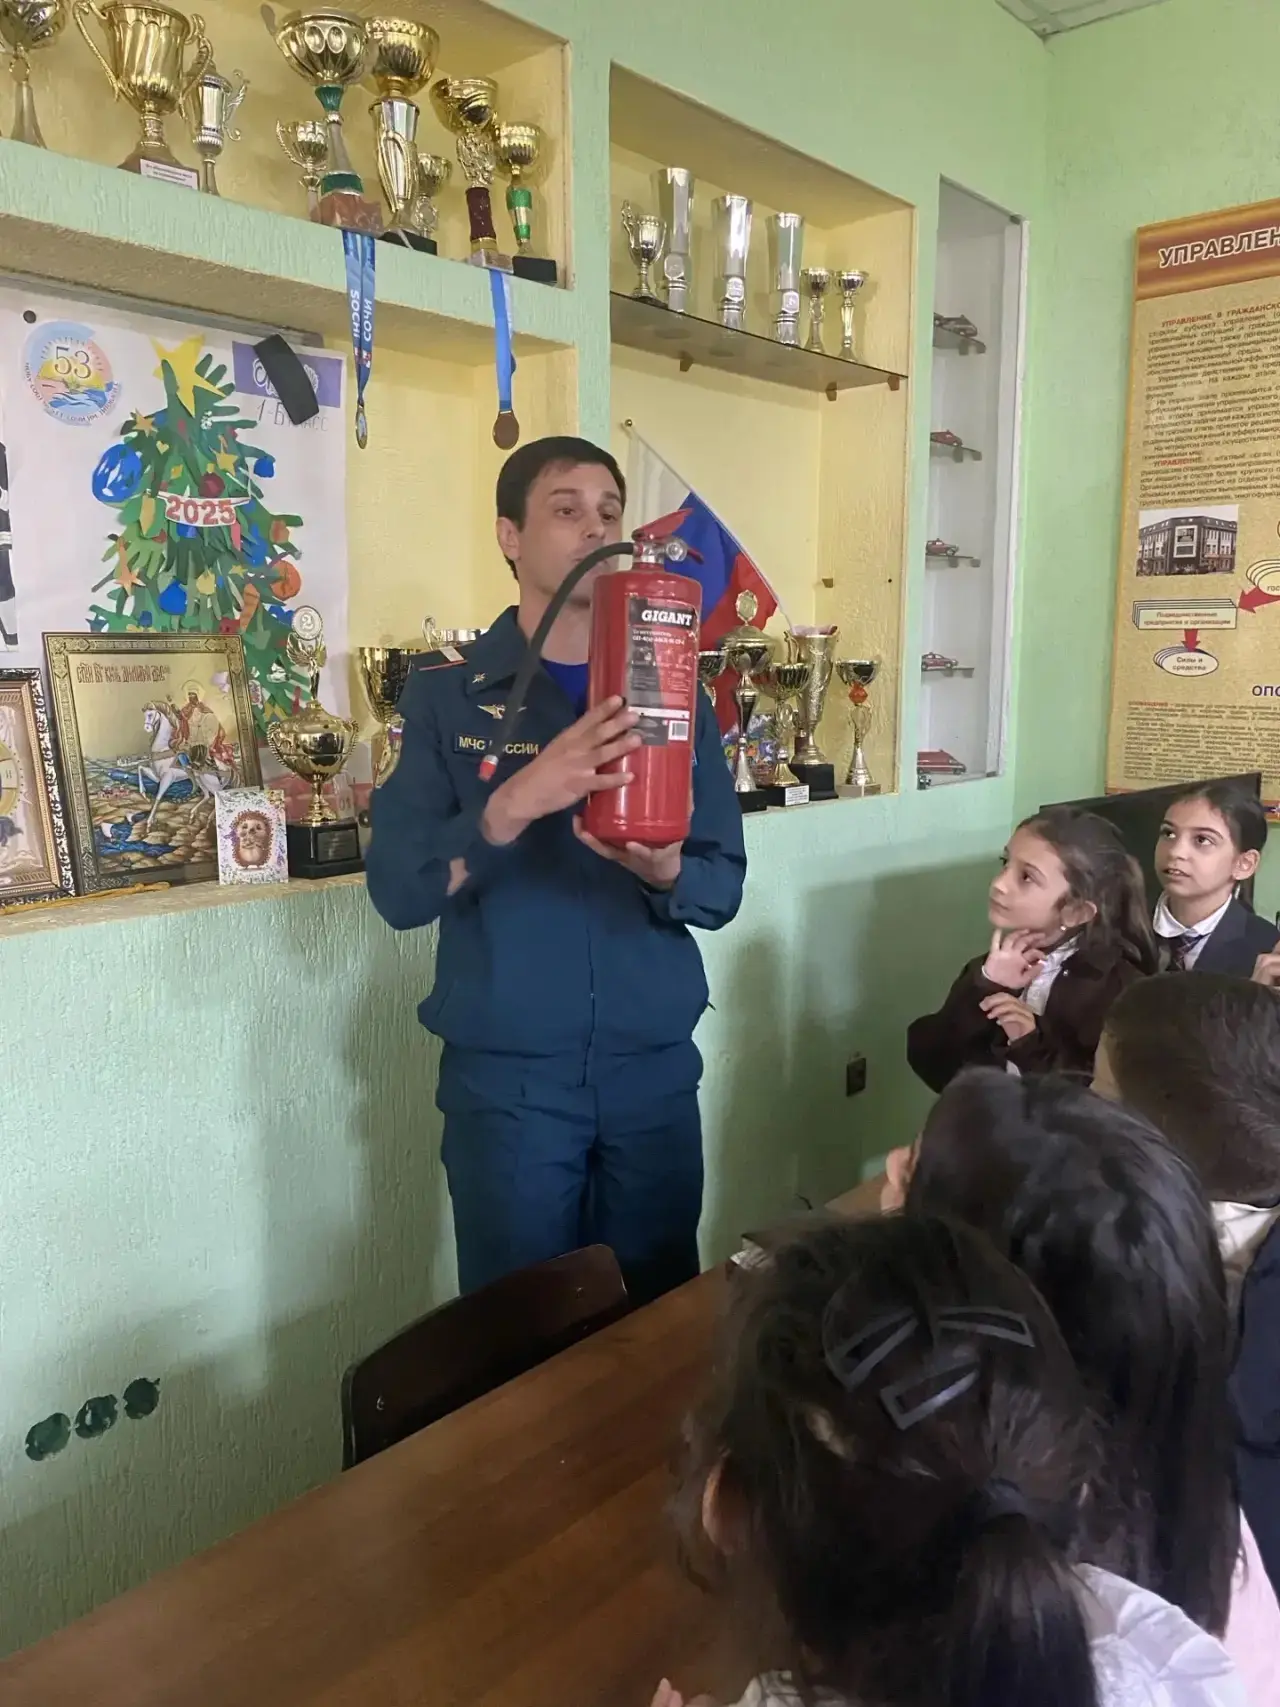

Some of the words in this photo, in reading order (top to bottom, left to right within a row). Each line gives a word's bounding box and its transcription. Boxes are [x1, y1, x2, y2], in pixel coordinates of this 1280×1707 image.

[1159, 227, 1280, 268] УПРАВЛЕН
[350, 289, 360, 338] SOCHI
[363, 298, 373, 342] СОЧИ
[1161, 313, 1213, 328] УПРАВЛЕНИЕ
[54, 346, 92, 379] 53
[166, 495, 236, 525] 2025
[302, 614, 314, 630] 2
[641, 609, 692, 626] GIGANT
[458, 735, 486, 750] МЧС
[489, 740, 539, 755] ССИИ
